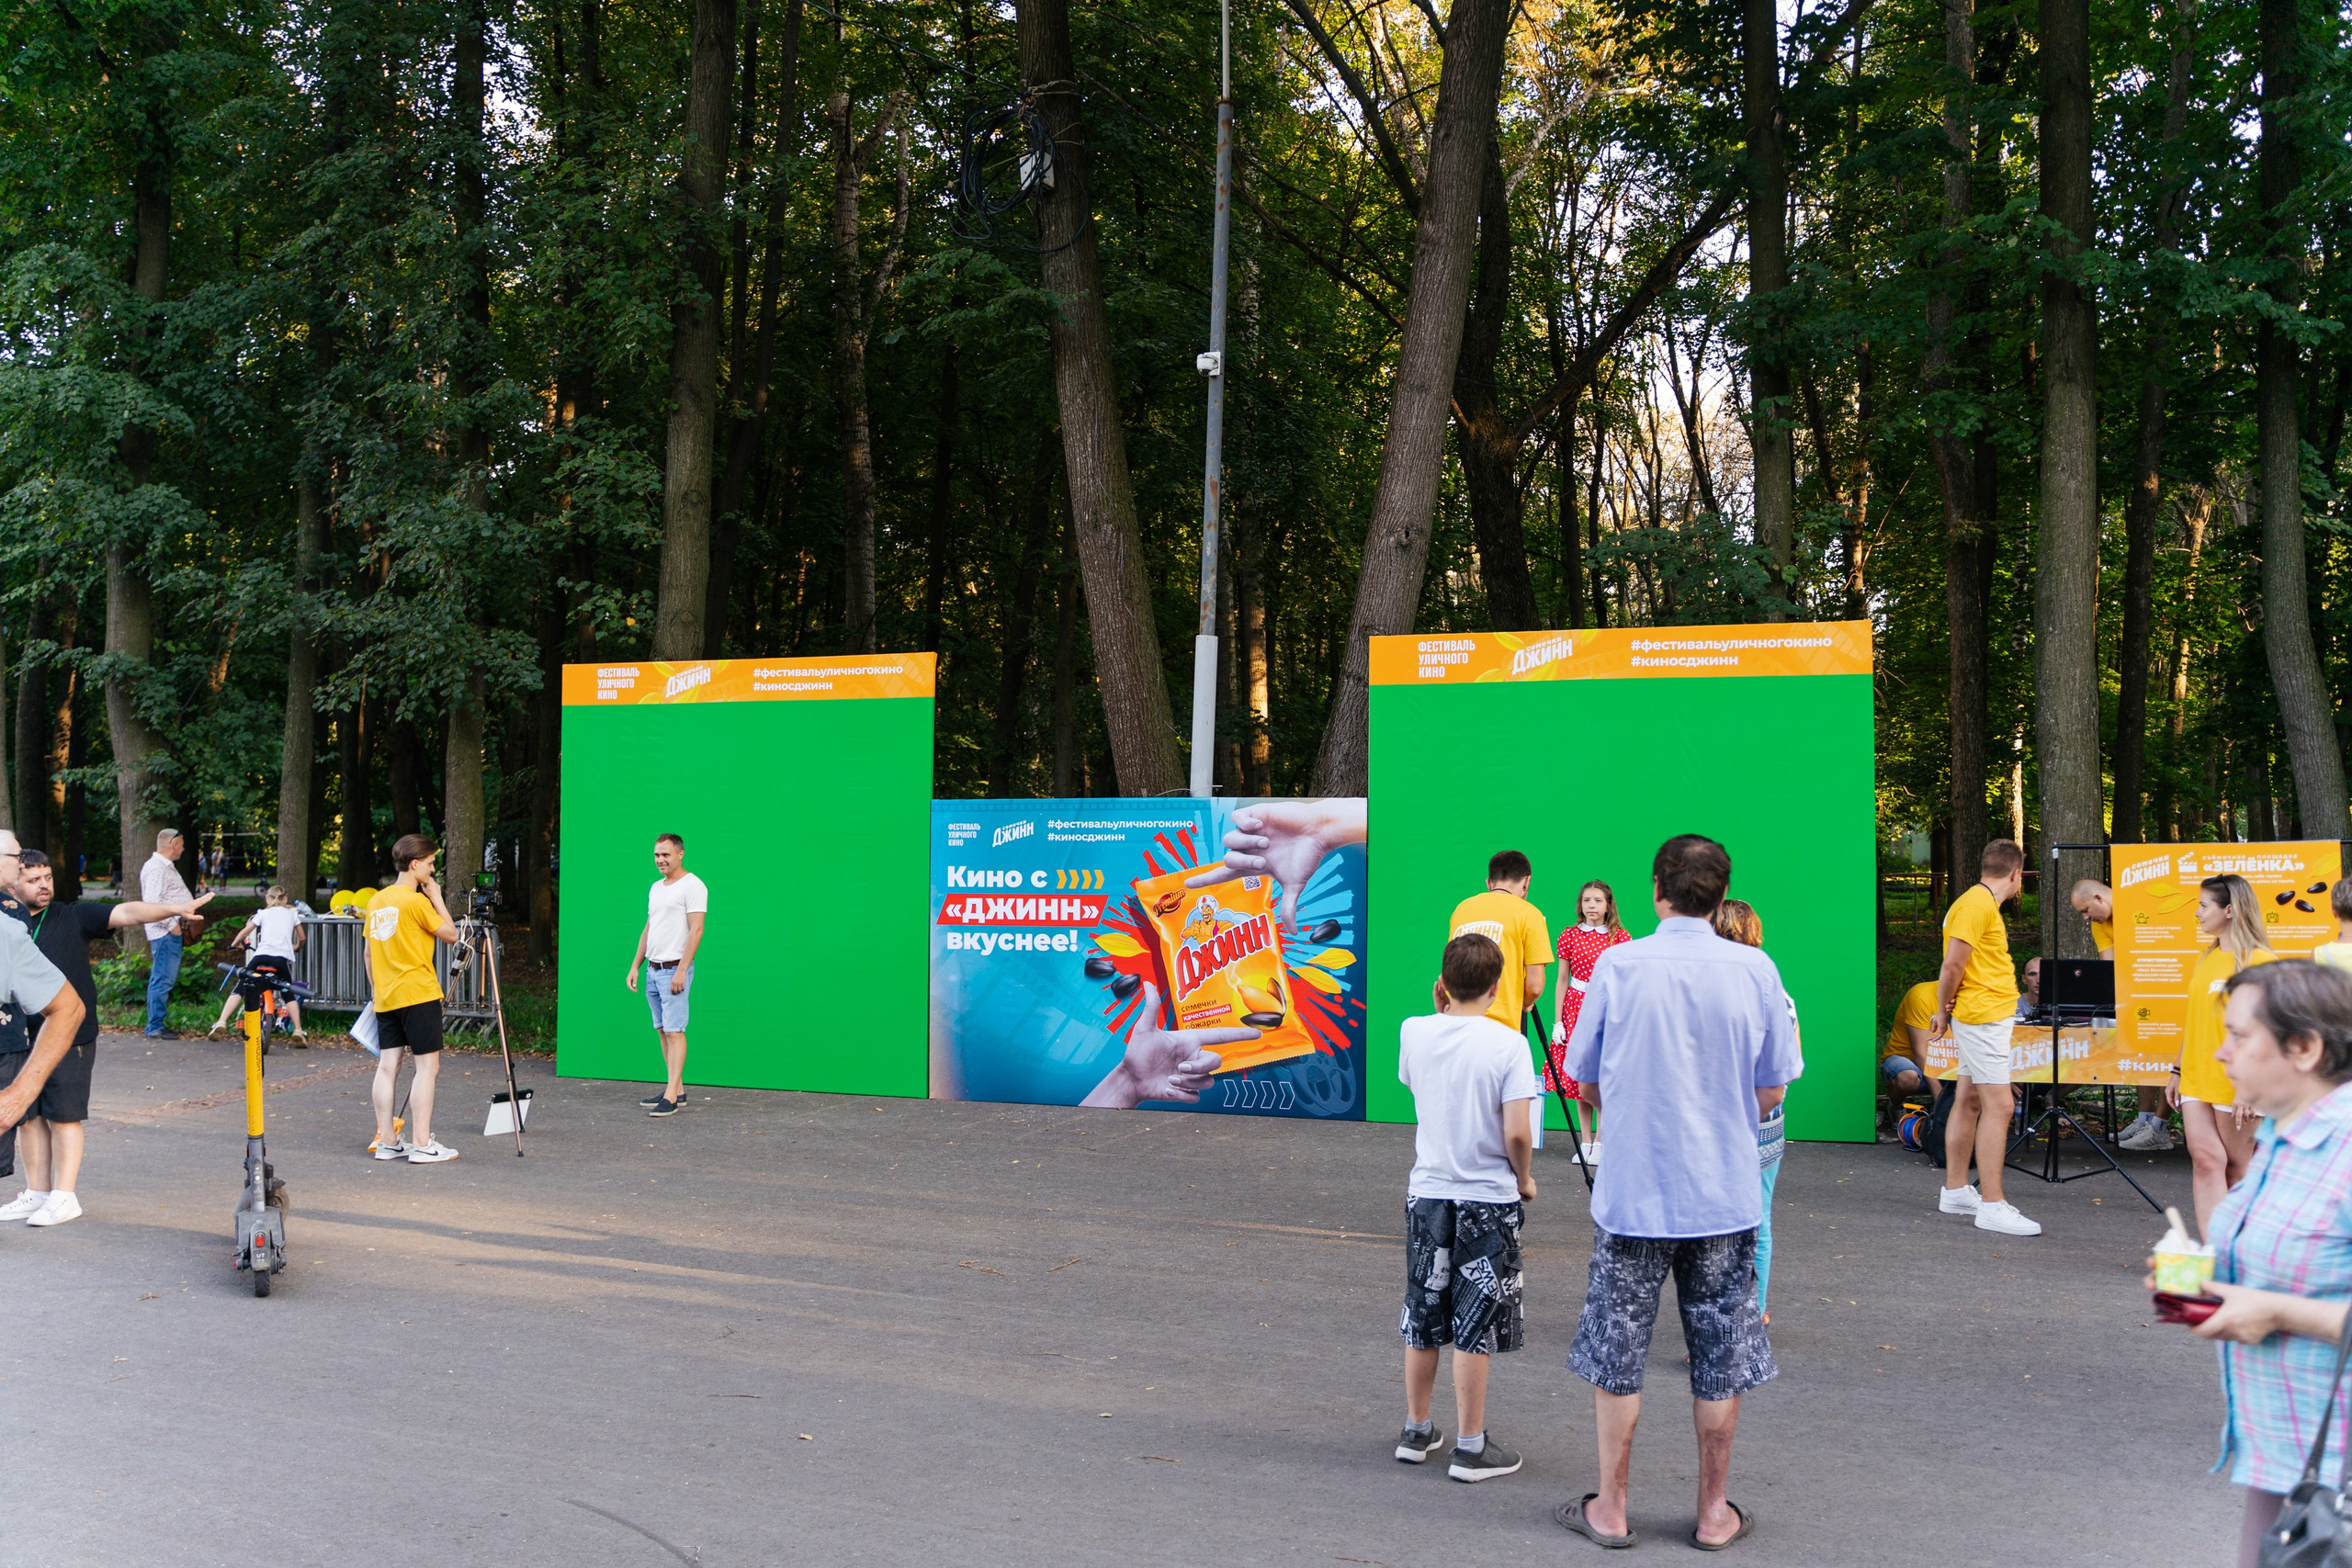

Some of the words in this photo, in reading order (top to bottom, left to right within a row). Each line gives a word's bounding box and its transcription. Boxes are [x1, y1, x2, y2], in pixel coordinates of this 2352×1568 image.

[1418, 639, 1476, 652] ФЕСТИВАЛЬ
[1631, 637, 1832, 652] #фестивальуличногокино
[1418, 652, 1468, 665] УЛИЧНОГО
[1631, 655, 1738, 668] #киносджинн
[597, 667, 639, 678] ФЕСТИВАЛЬ
[752, 665, 903, 680] #фестивальуличногокино
[1419, 666, 1445, 678] КИНО
[597, 678, 635, 689] УЛИЧНОГО
[752, 682, 833, 692] #киносджинн
[597, 690, 617, 700] КИНО
[1047, 818, 1193, 830] #фестивальуличногокино
[1047, 832, 1125, 842] #киносджинн
[2203, 857, 2305, 872] «ЗЕЛЁНКА»
[947, 865, 1023, 888] Кино
[1030, 870, 1047, 888] с
[1153, 889, 1185, 917] Premium
[945, 897, 1100, 924] «ДЖИНН»
[947, 930, 1078, 956] вкуснее!
[1182, 999, 1217, 1012] семечки
[1183, 1005, 1231, 1021] качественной
[1185, 1018, 1221, 1030] обжарки
